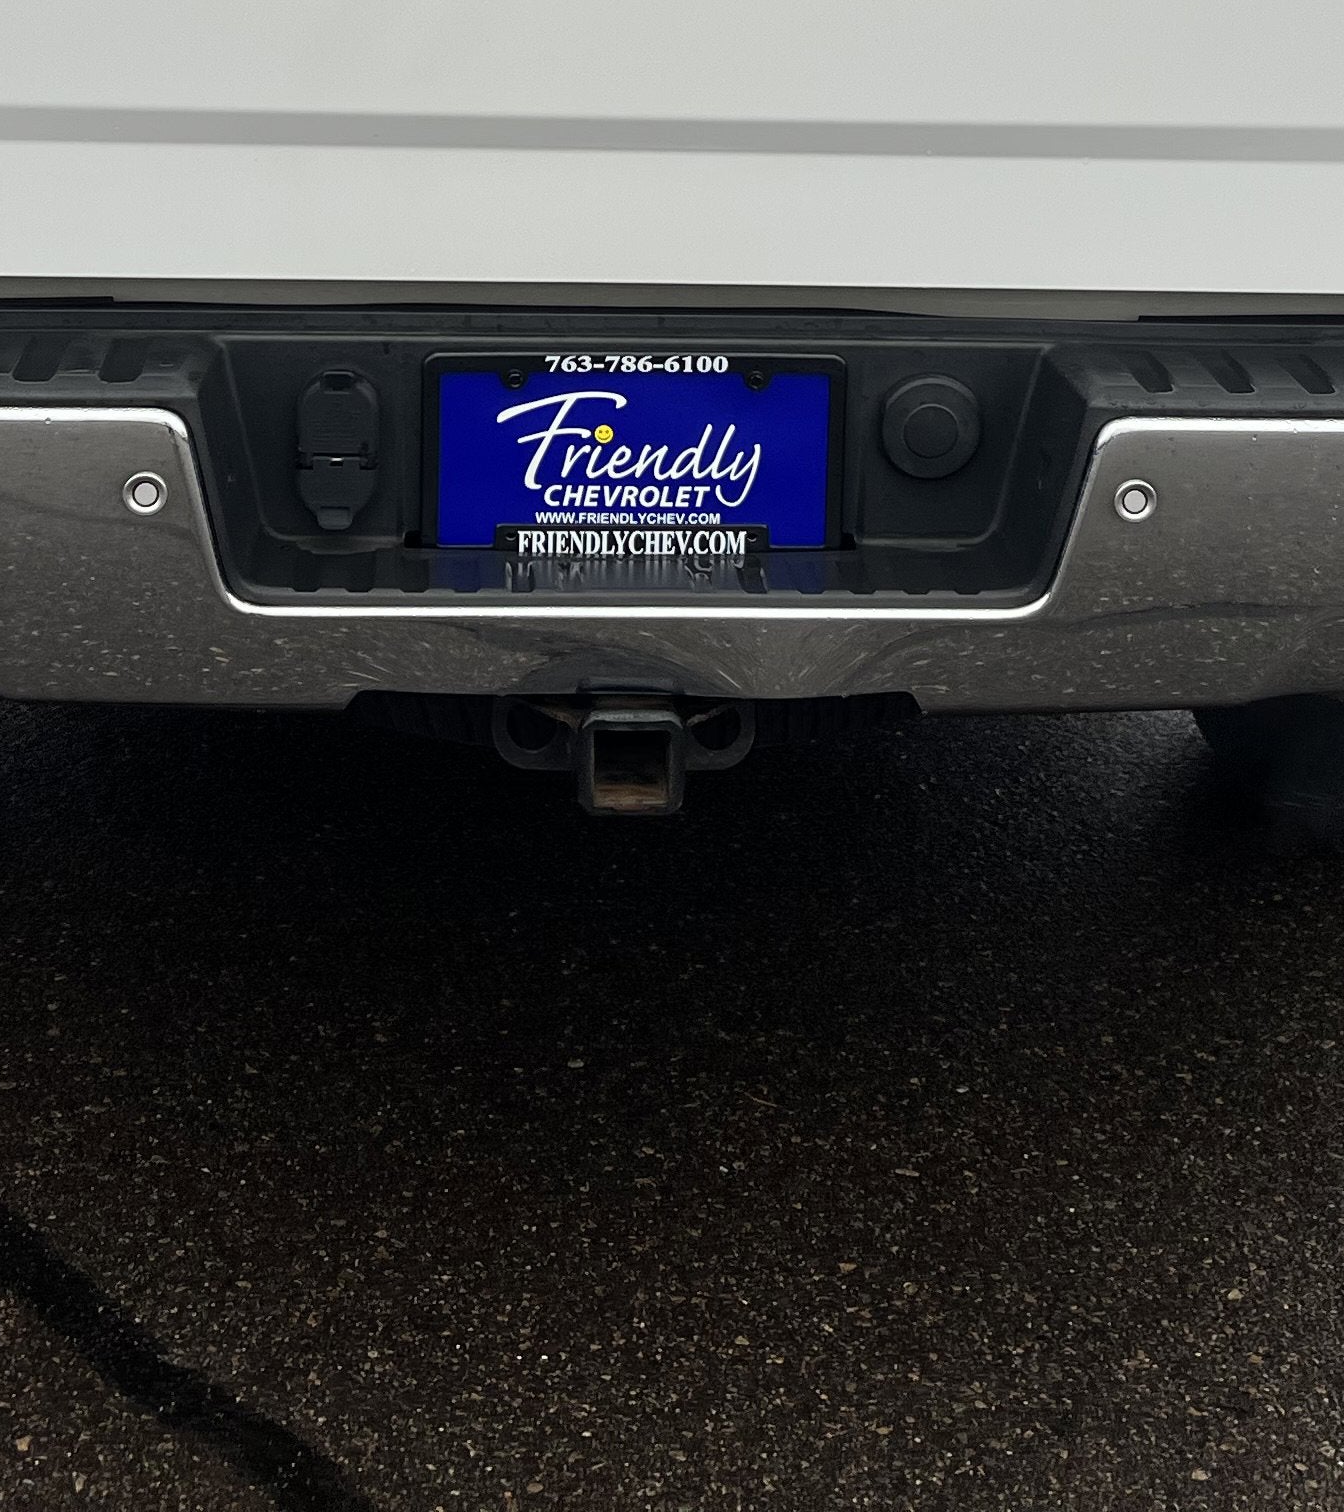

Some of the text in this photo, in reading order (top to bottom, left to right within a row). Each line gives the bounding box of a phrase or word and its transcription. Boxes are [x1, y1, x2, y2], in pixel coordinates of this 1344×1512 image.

[545, 355, 729, 373] 763-786-6100
[496, 391, 761, 507] Friendly
[544, 485, 710, 507] CHEVROLET
[535, 511, 721, 525] WWW.FRIENDLYCHEV.COM
[517, 530, 747, 555] FRIENDLYCHEV.COM
